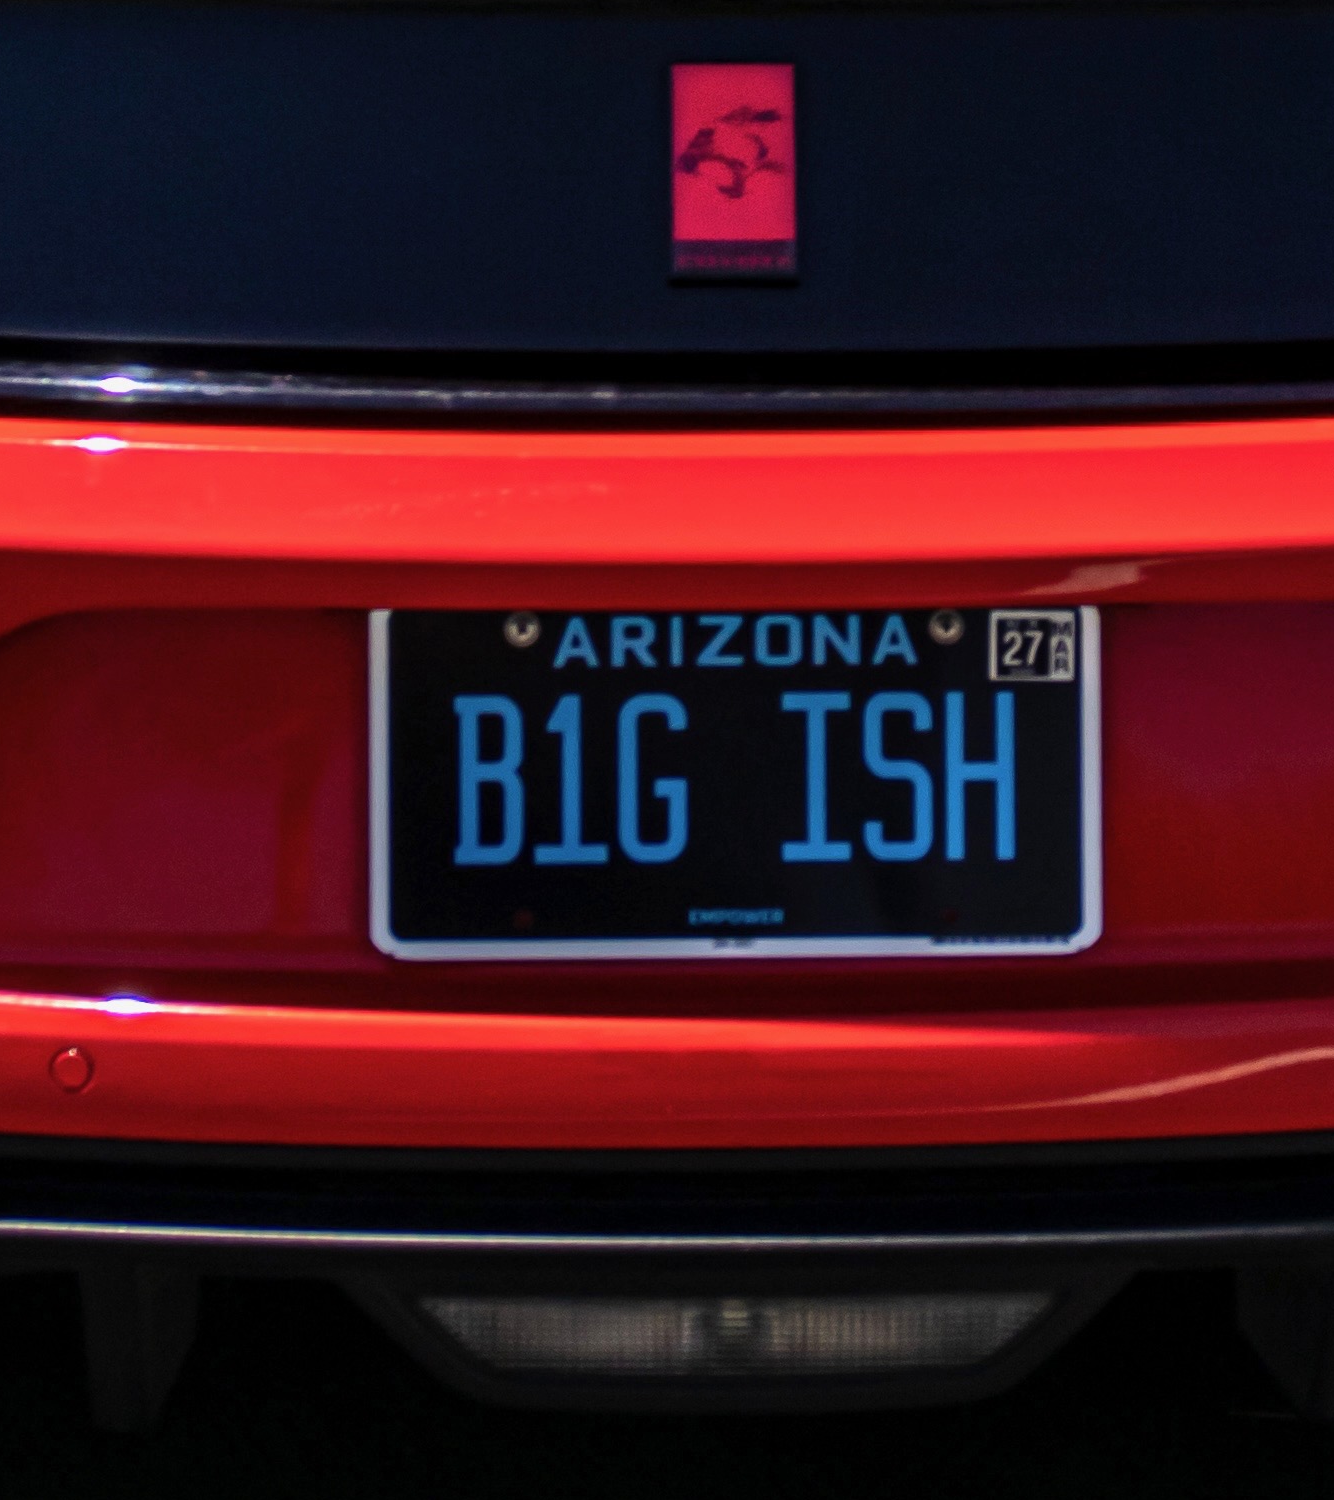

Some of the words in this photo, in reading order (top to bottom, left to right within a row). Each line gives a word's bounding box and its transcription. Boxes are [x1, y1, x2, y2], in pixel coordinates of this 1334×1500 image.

[552, 614, 919, 669] ARIZONA
[1002, 630, 1044, 667] 27
[453, 692, 689, 865] B1G
[781, 690, 1016, 863] ISH
